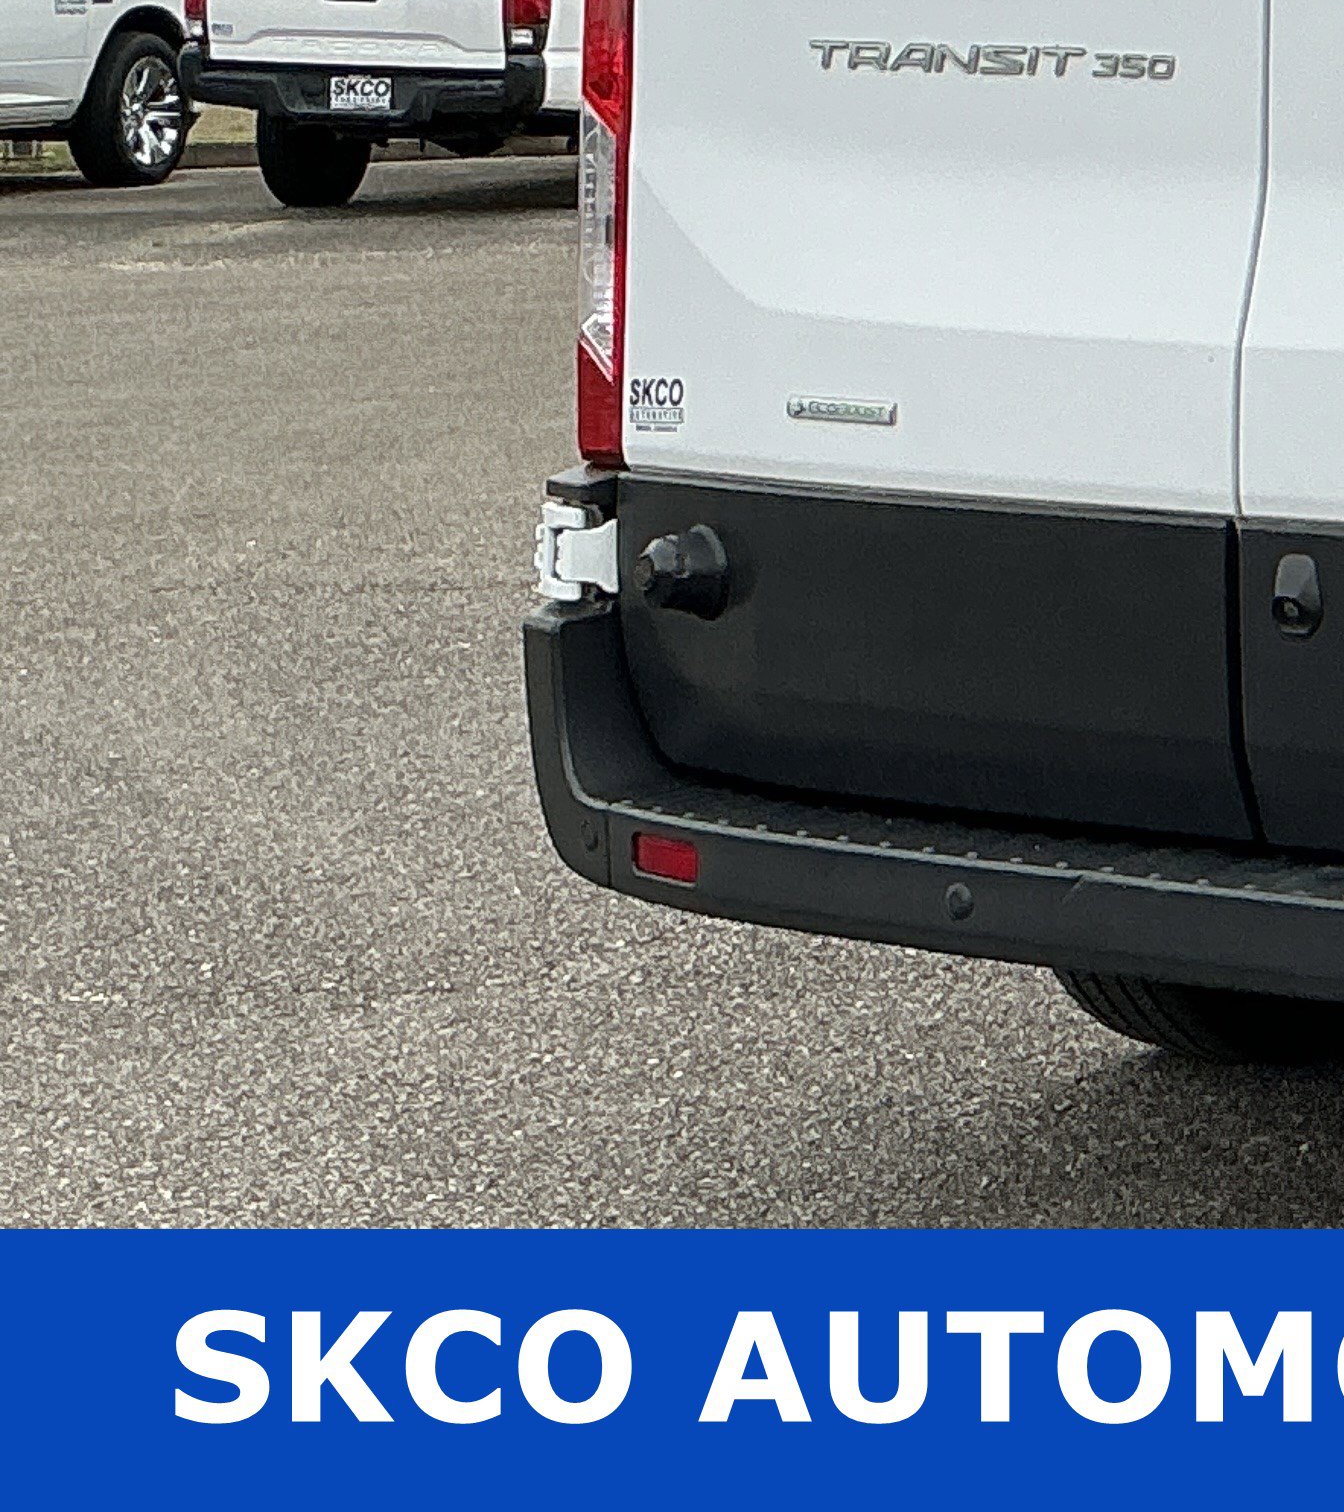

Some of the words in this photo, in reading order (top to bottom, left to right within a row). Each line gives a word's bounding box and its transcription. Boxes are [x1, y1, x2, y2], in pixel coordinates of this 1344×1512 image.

[809, 39, 1088, 77] TRANSIT
[1091, 52, 1177, 79] 350
[332, 79, 391, 98] SKCO
[629, 378, 684, 406] SKCO
